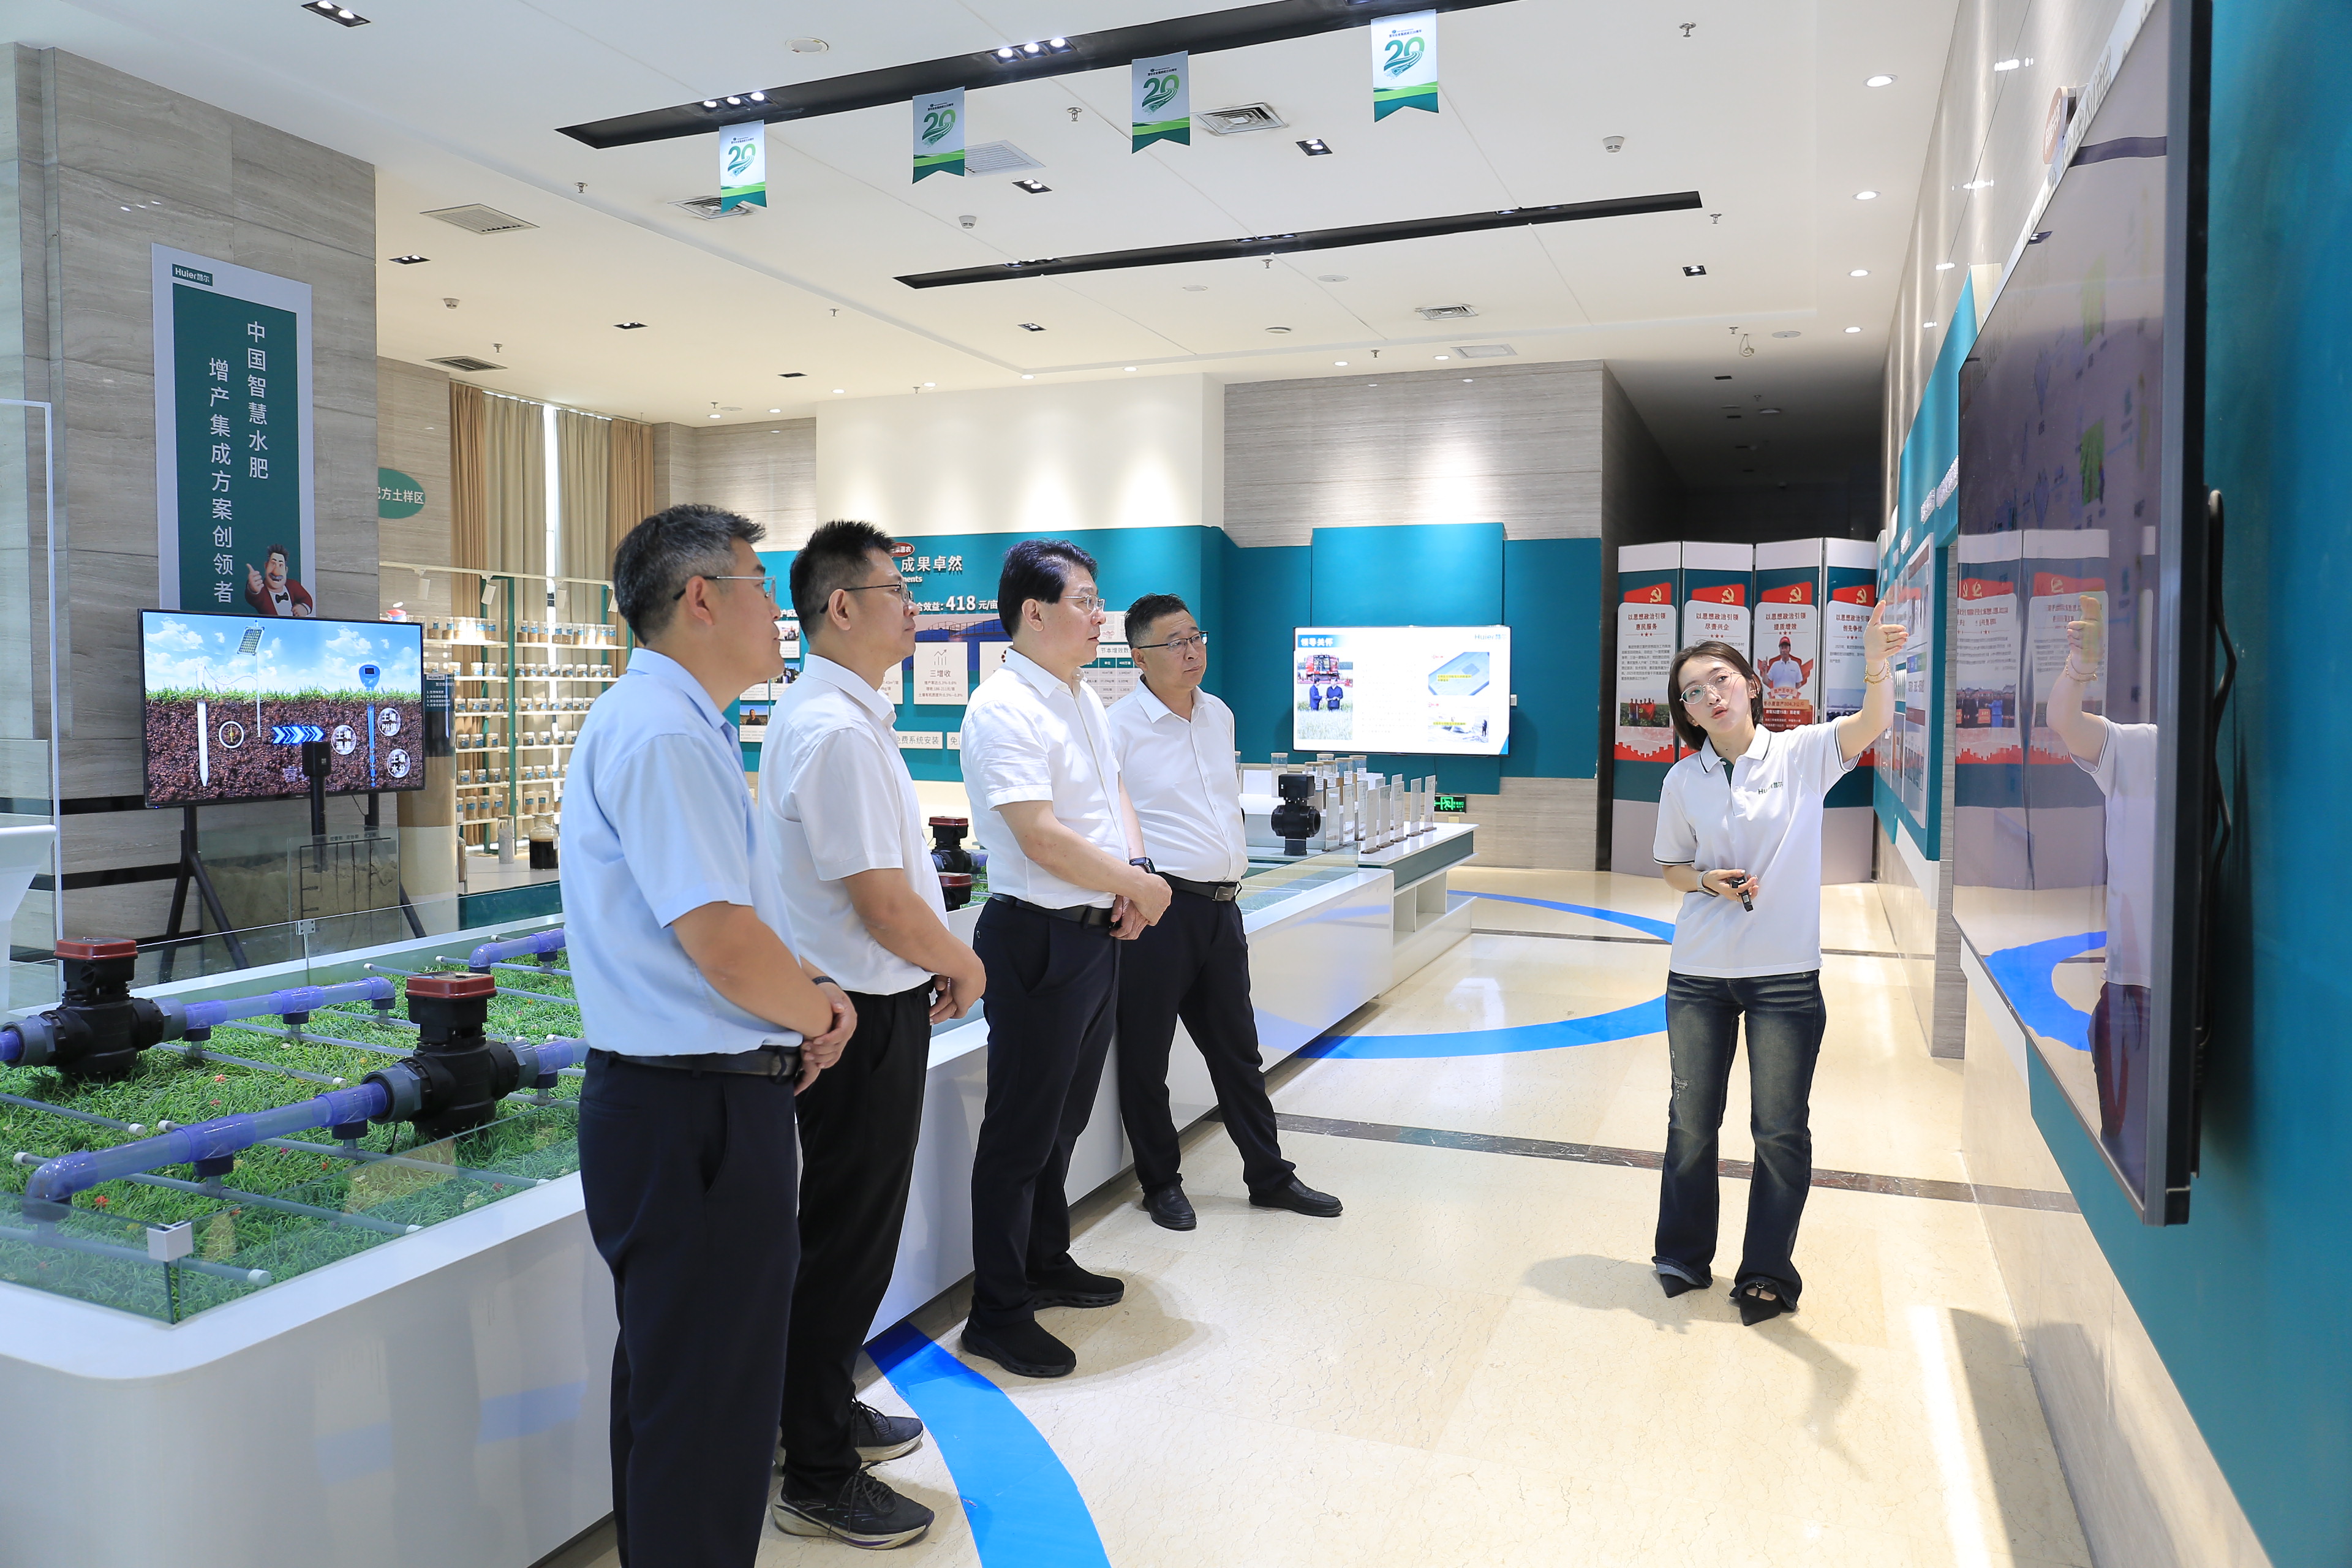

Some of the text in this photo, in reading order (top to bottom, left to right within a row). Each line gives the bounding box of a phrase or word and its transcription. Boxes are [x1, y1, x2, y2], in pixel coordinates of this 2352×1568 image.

[1384, 37, 1425, 75] 20
[1142, 74, 1179, 111] 20
[922, 109, 956, 143] 20
[728, 143, 756, 173] 20
[247, 321, 268, 480] 中国智慧水肥
[209, 356, 233, 603] 增产集成方案创领者
[901, 555, 963, 573] 成果卓然
[946, 595, 976, 611] 418
[336, 730, 352, 739] 土壤
[950, 736, 960, 745] 免
[336, 741, 352, 750] 温度
[391, 754, 405, 763] 土壤
[391, 764, 405, 773] 水分
[1758, 782, 1783, 794] Hur慧尔
